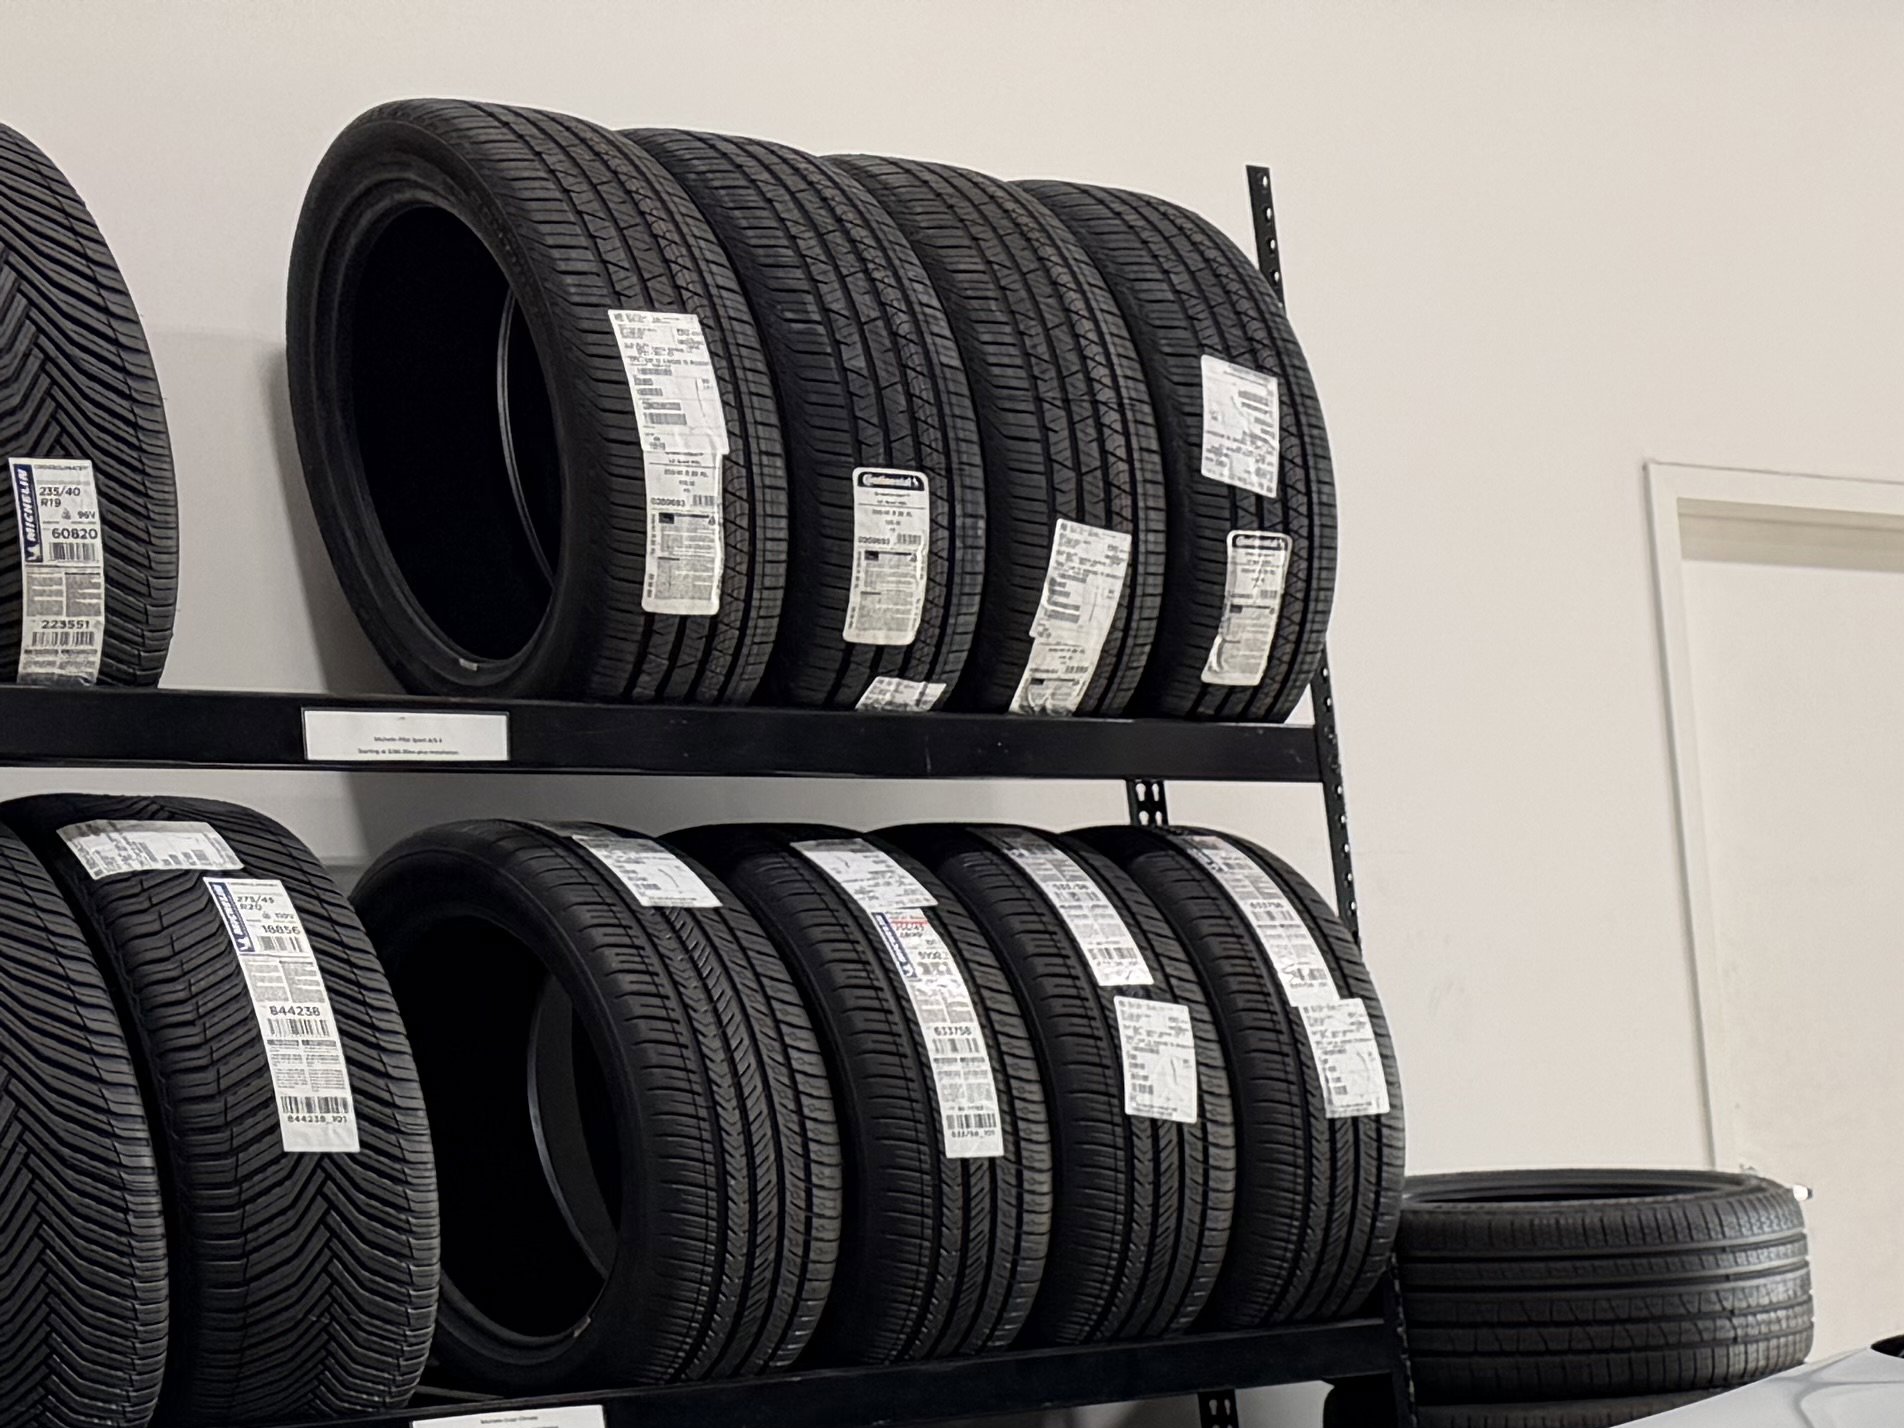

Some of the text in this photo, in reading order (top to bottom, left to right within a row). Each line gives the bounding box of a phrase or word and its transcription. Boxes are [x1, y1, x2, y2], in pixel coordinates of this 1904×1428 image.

[39, 486, 81, 497] 235/40
[16, 468, 37, 543] MICHELIN
[41, 498, 62, 508] R19
[51, 528, 98, 540] 60820
[41, 619, 90, 630] 223551
[269, 1005, 322, 1017] 844238
